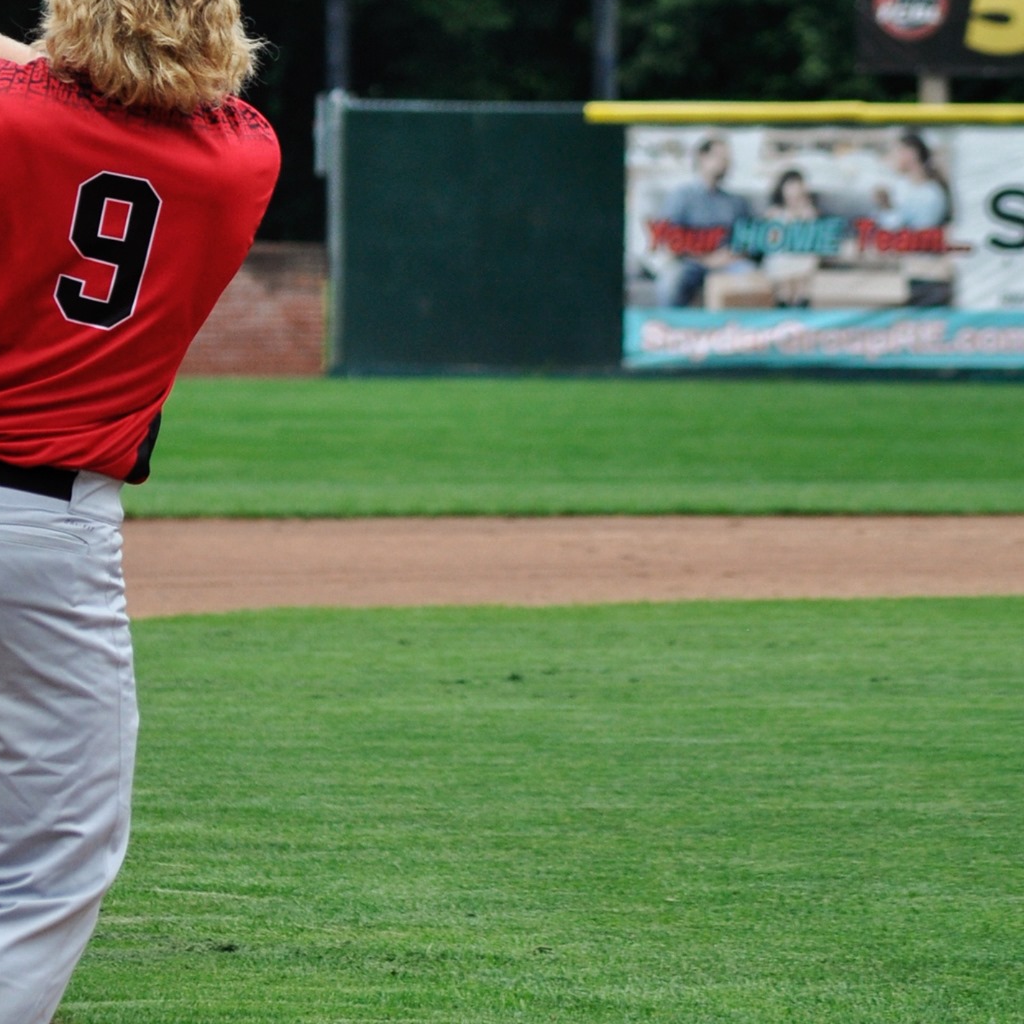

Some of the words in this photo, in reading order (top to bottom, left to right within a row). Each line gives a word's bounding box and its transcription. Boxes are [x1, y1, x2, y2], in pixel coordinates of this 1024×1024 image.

[53, 170, 163, 331] 9
[648, 219, 725, 255] Your
[731, 216, 845, 255] HOME
